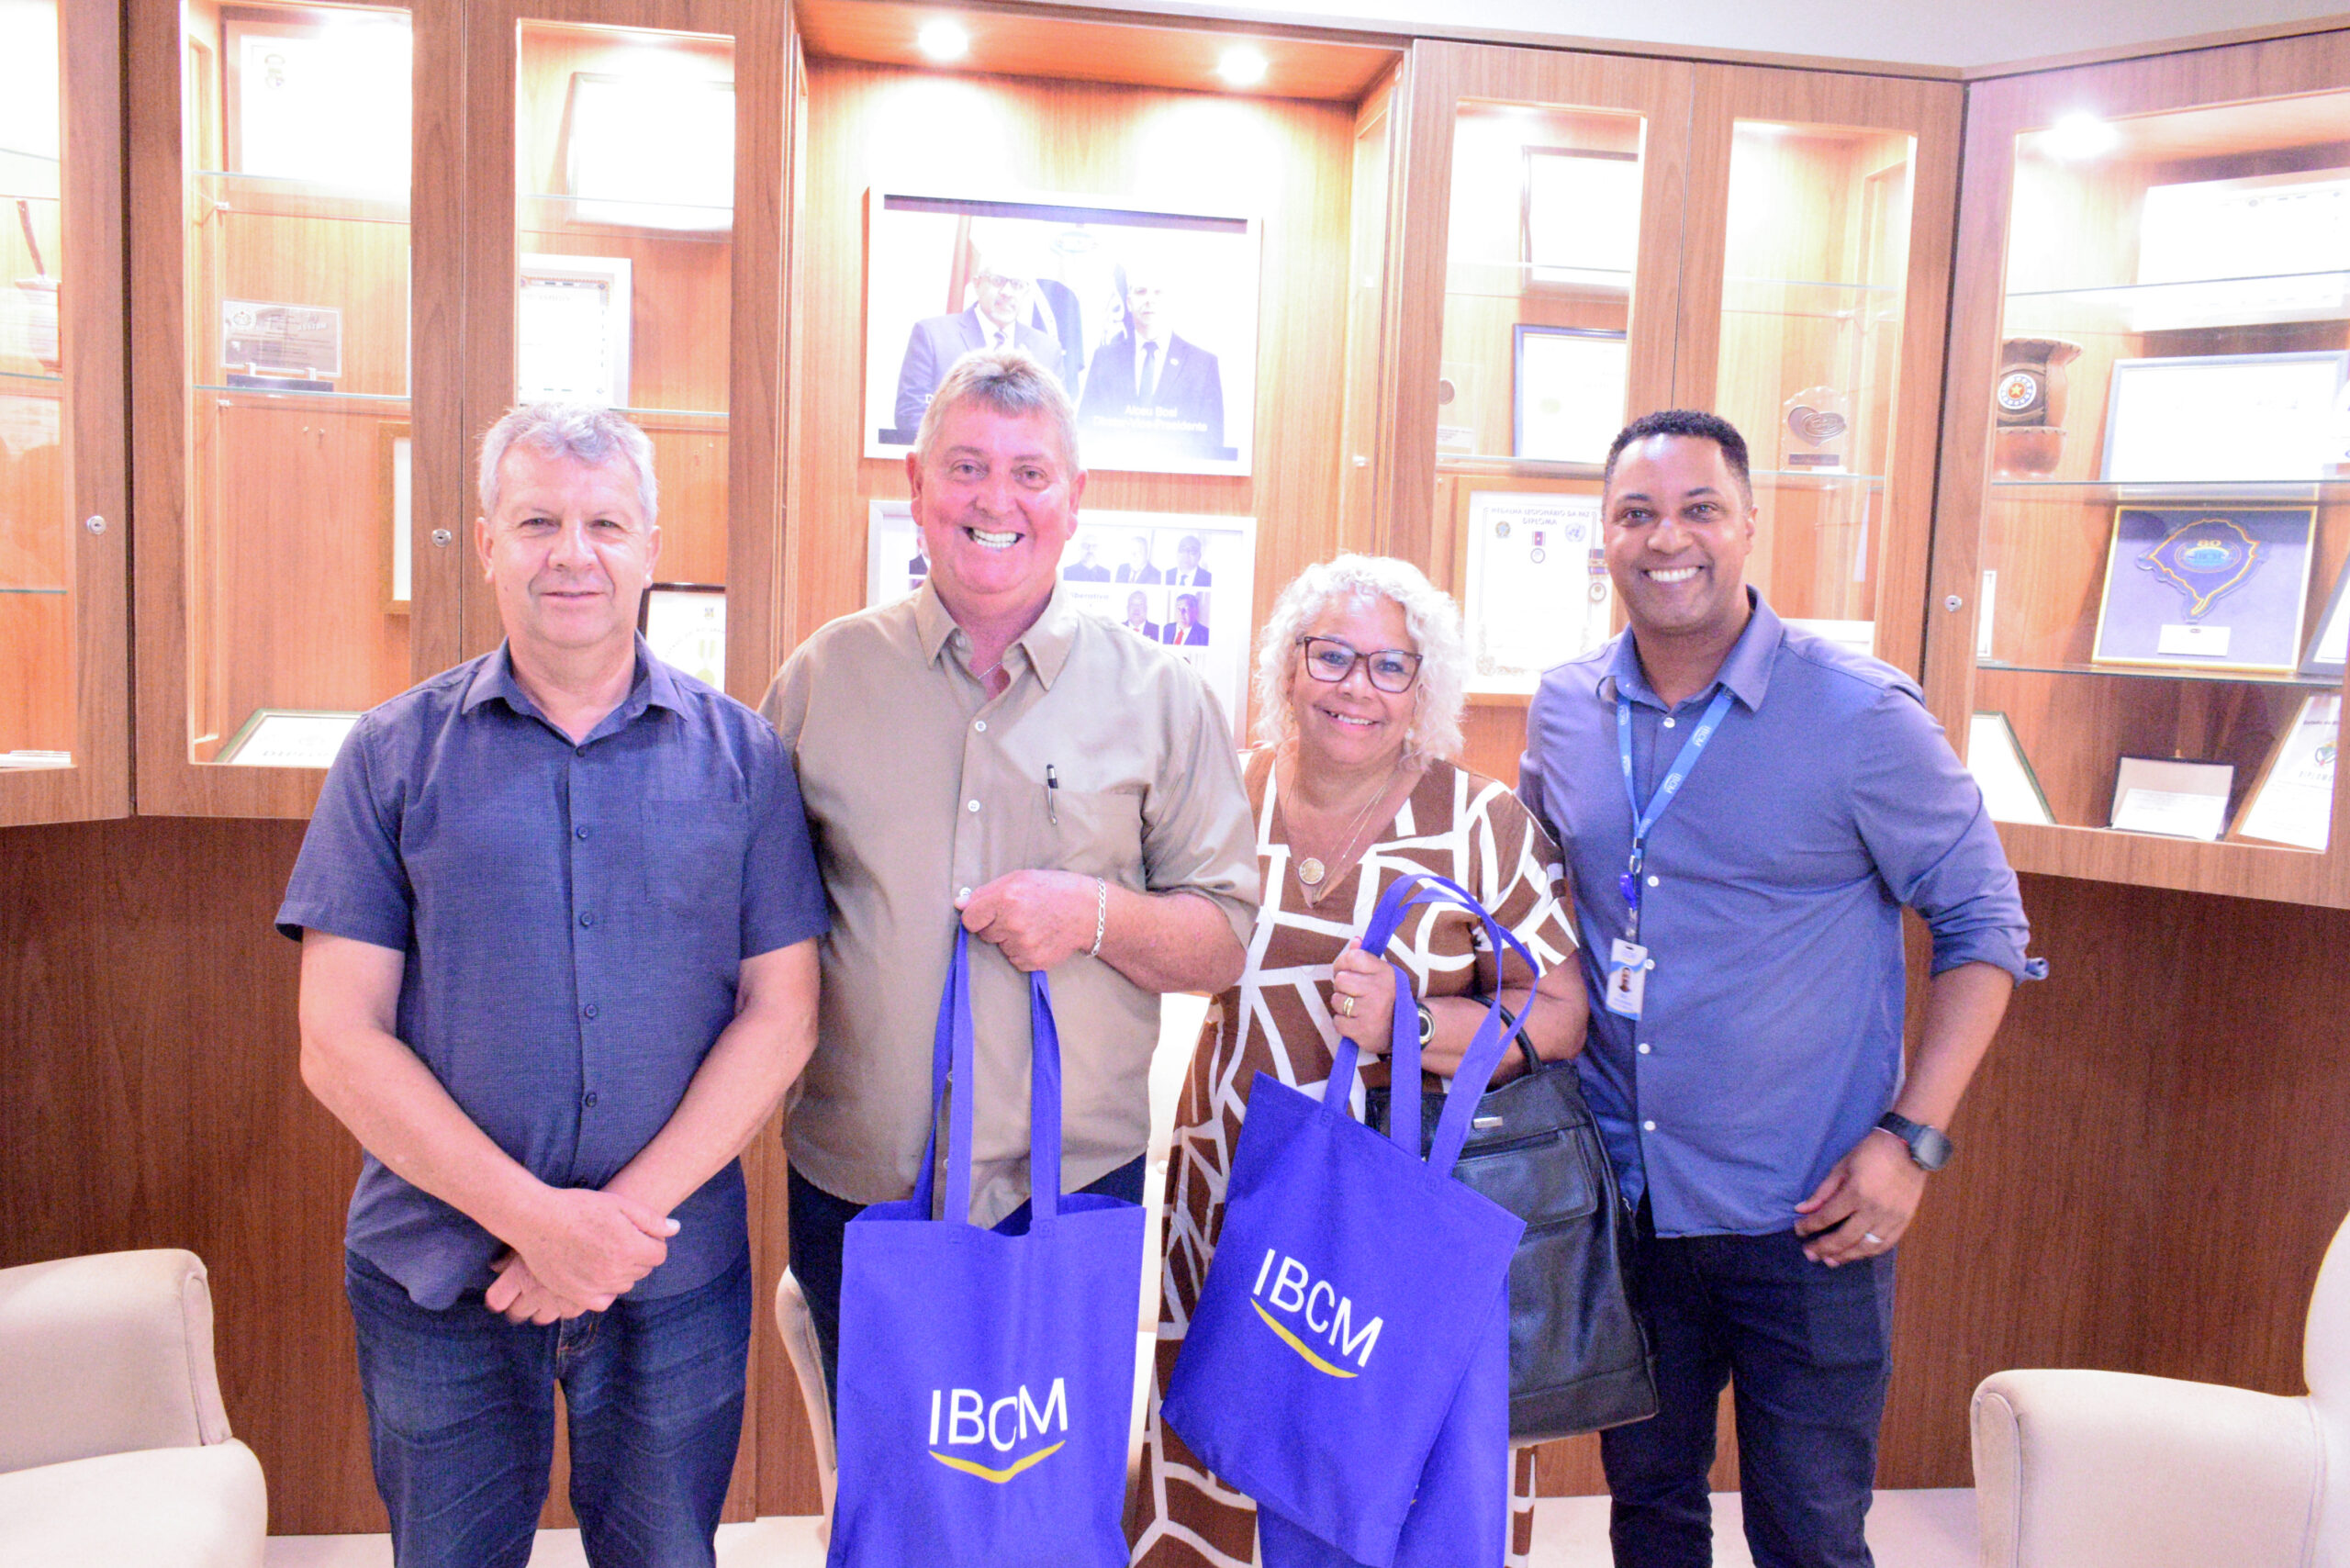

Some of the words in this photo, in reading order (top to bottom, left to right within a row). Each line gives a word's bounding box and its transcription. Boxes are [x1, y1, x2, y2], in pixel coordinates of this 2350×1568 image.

[1522, 517, 1557, 525] DIPLOMA
[1695, 725, 1712, 747] IBCM
[1667, 773, 1683, 794] IBCM
[1252, 1248, 1383, 1368] IBCM
[929, 1377, 1069, 1452] IBCM
